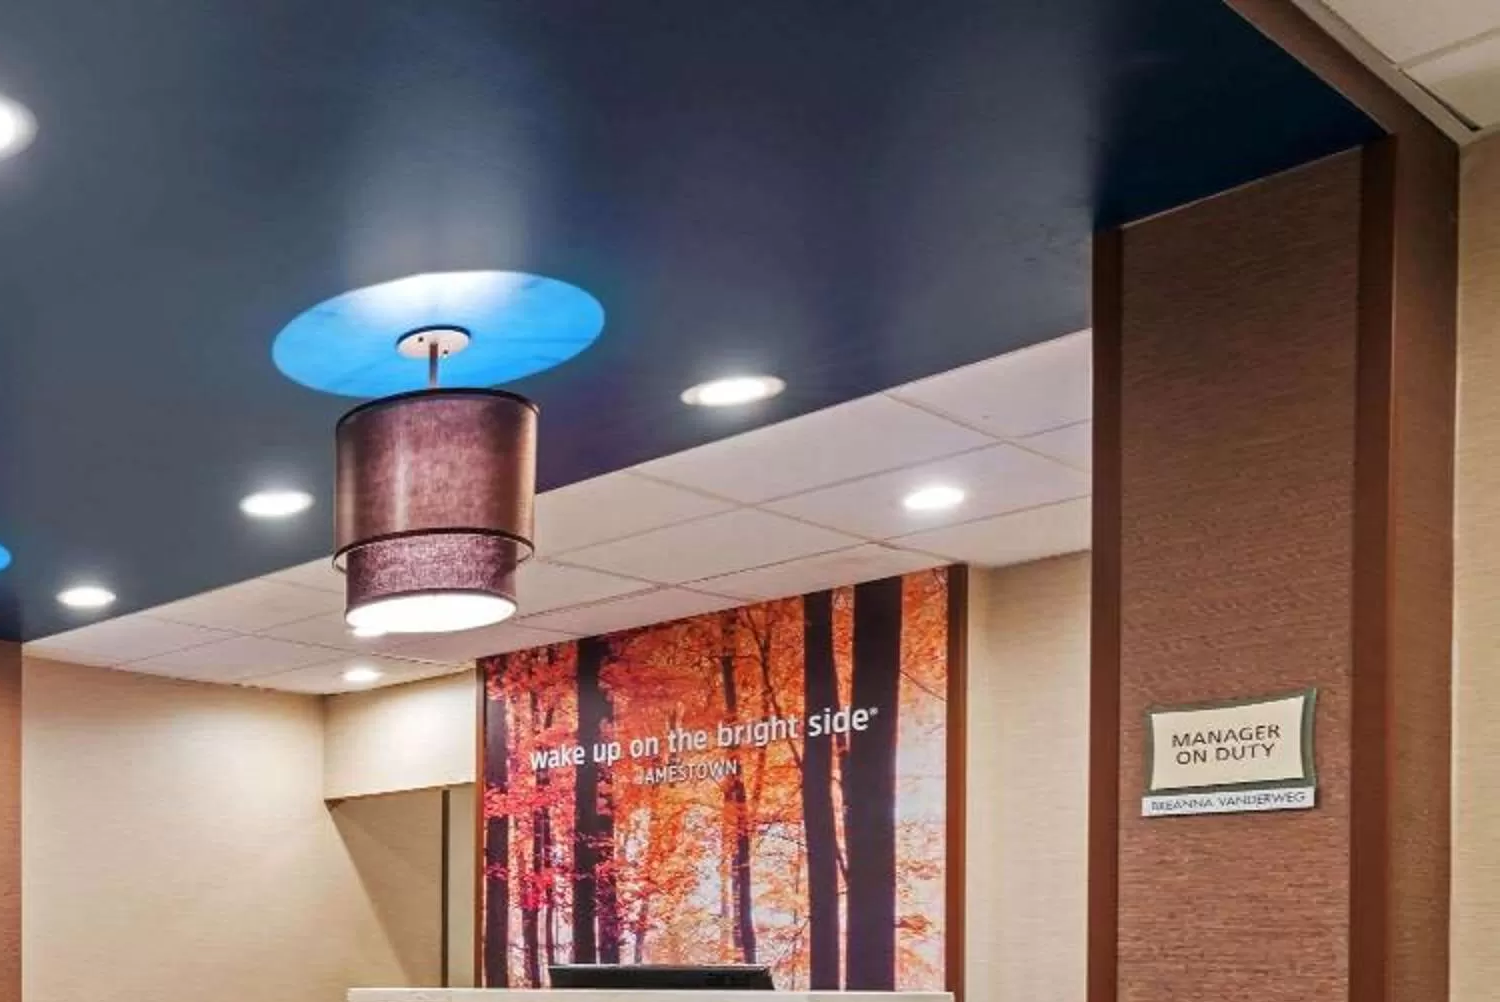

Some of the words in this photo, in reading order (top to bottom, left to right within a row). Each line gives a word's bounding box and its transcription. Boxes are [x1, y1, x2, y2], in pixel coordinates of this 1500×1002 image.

[530, 743, 585, 769] wake
[593, 740, 621, 766] up
[629, 736, 659, 758] on
[668, 726, 707, 753] the
[717, 713, 799, 747] bright
[1172, 724, 1281, 748] MANAGER
[1176, 750, 1207, 765] ON
[1216, 743, 1275, 761] DUTY
[638, 759, 738, 785] JAMESTOWN
